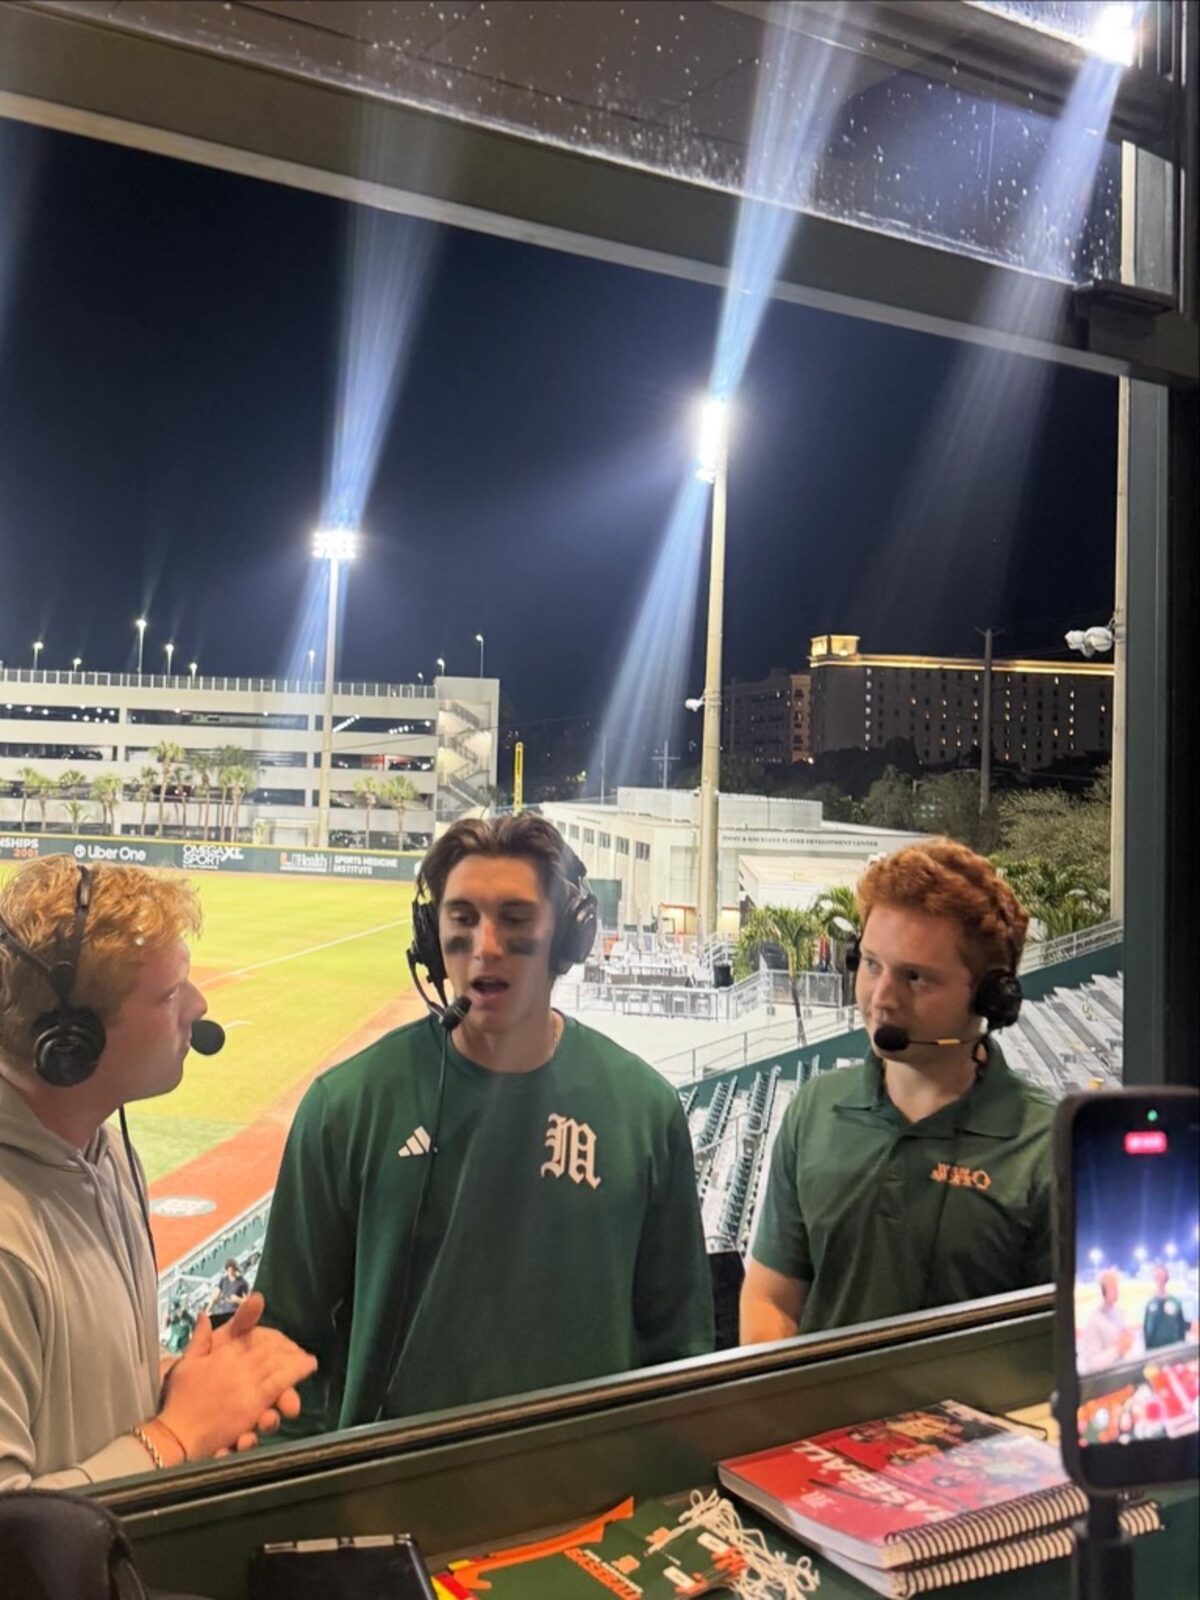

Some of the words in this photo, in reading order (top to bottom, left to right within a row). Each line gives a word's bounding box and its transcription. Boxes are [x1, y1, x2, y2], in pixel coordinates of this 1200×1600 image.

[806, 838, 851, 846] DEVELOPMENT
[88, 845, 119, 859] Uber
[119, 847, 146, 861] One
[183, 854, 221, 866] SPORT
[334, 856, 361, 866] SPORTS
[362, 857, 398, 868] MEDICINE
[333, 864, 373, 875] INSTITUTE
